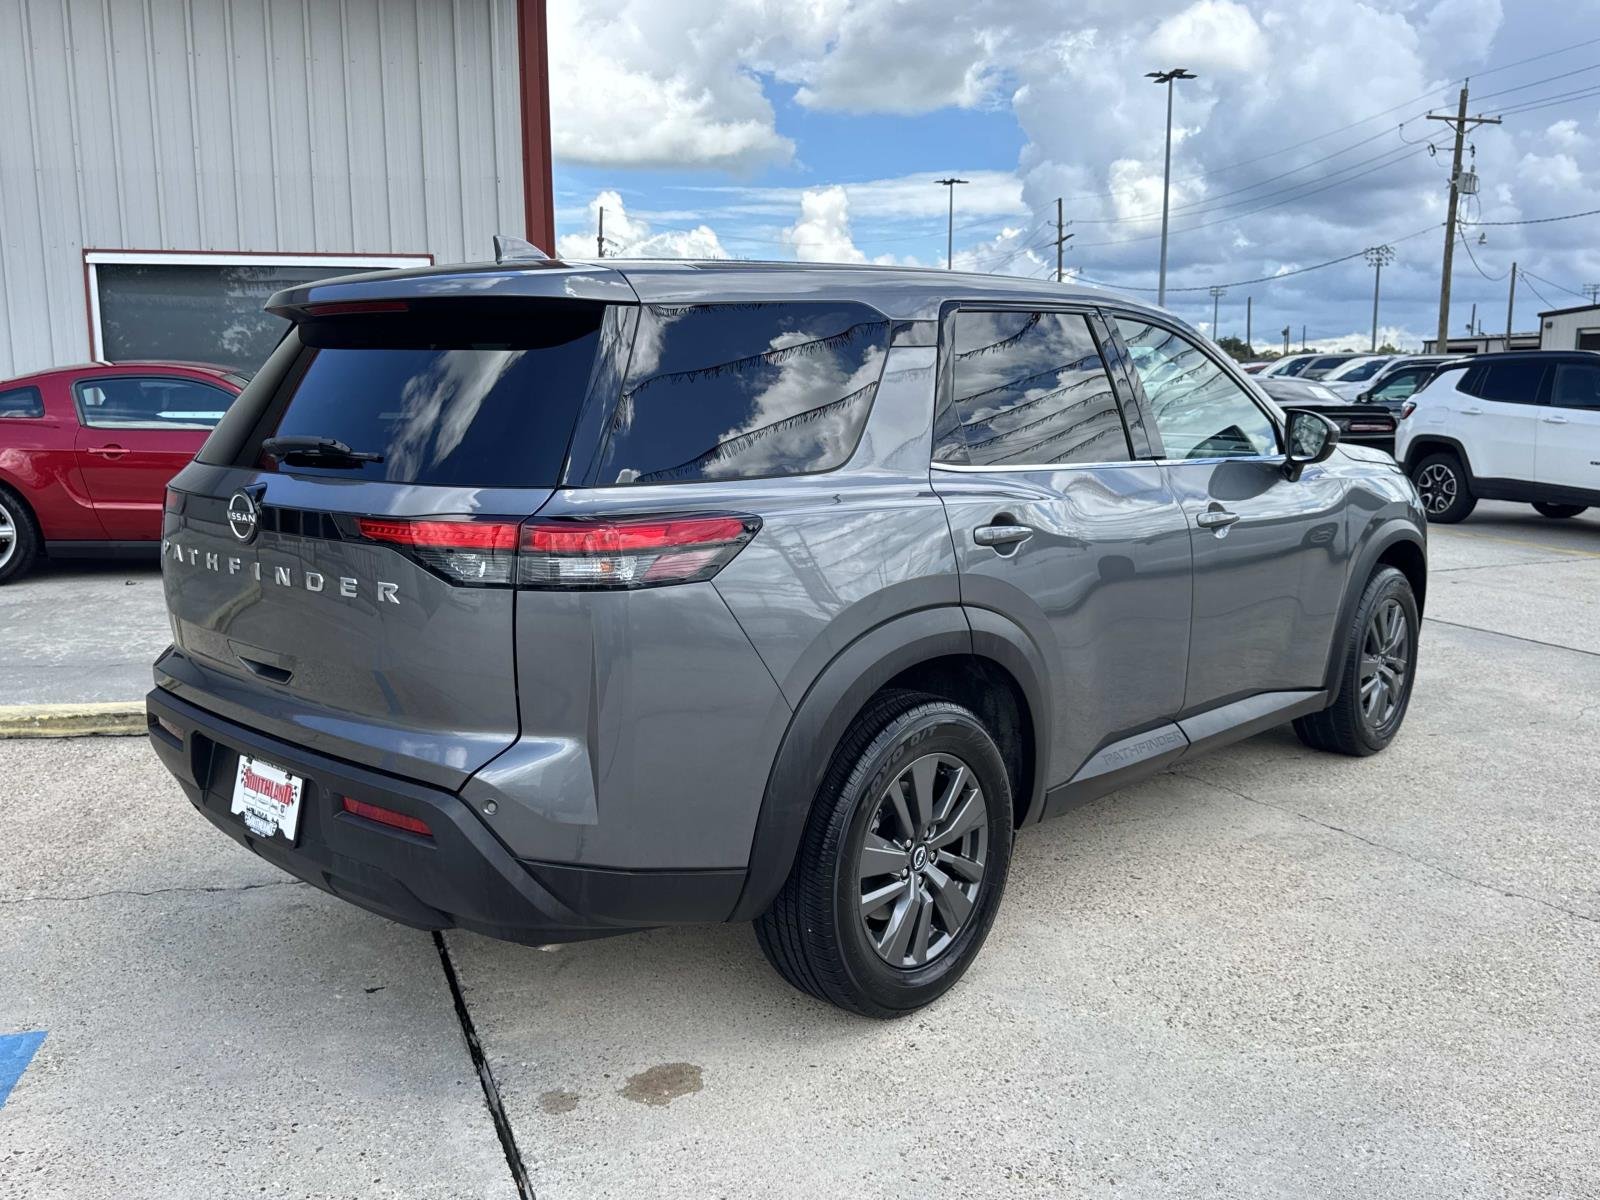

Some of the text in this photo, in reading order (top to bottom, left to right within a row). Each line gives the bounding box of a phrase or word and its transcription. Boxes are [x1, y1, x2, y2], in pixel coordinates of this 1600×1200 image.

[227, 509, 256, 523] SSAN
[163, 538, 400, 604] PATHFINDER
[1103, 730, 1183, 765] PATHFINDER
